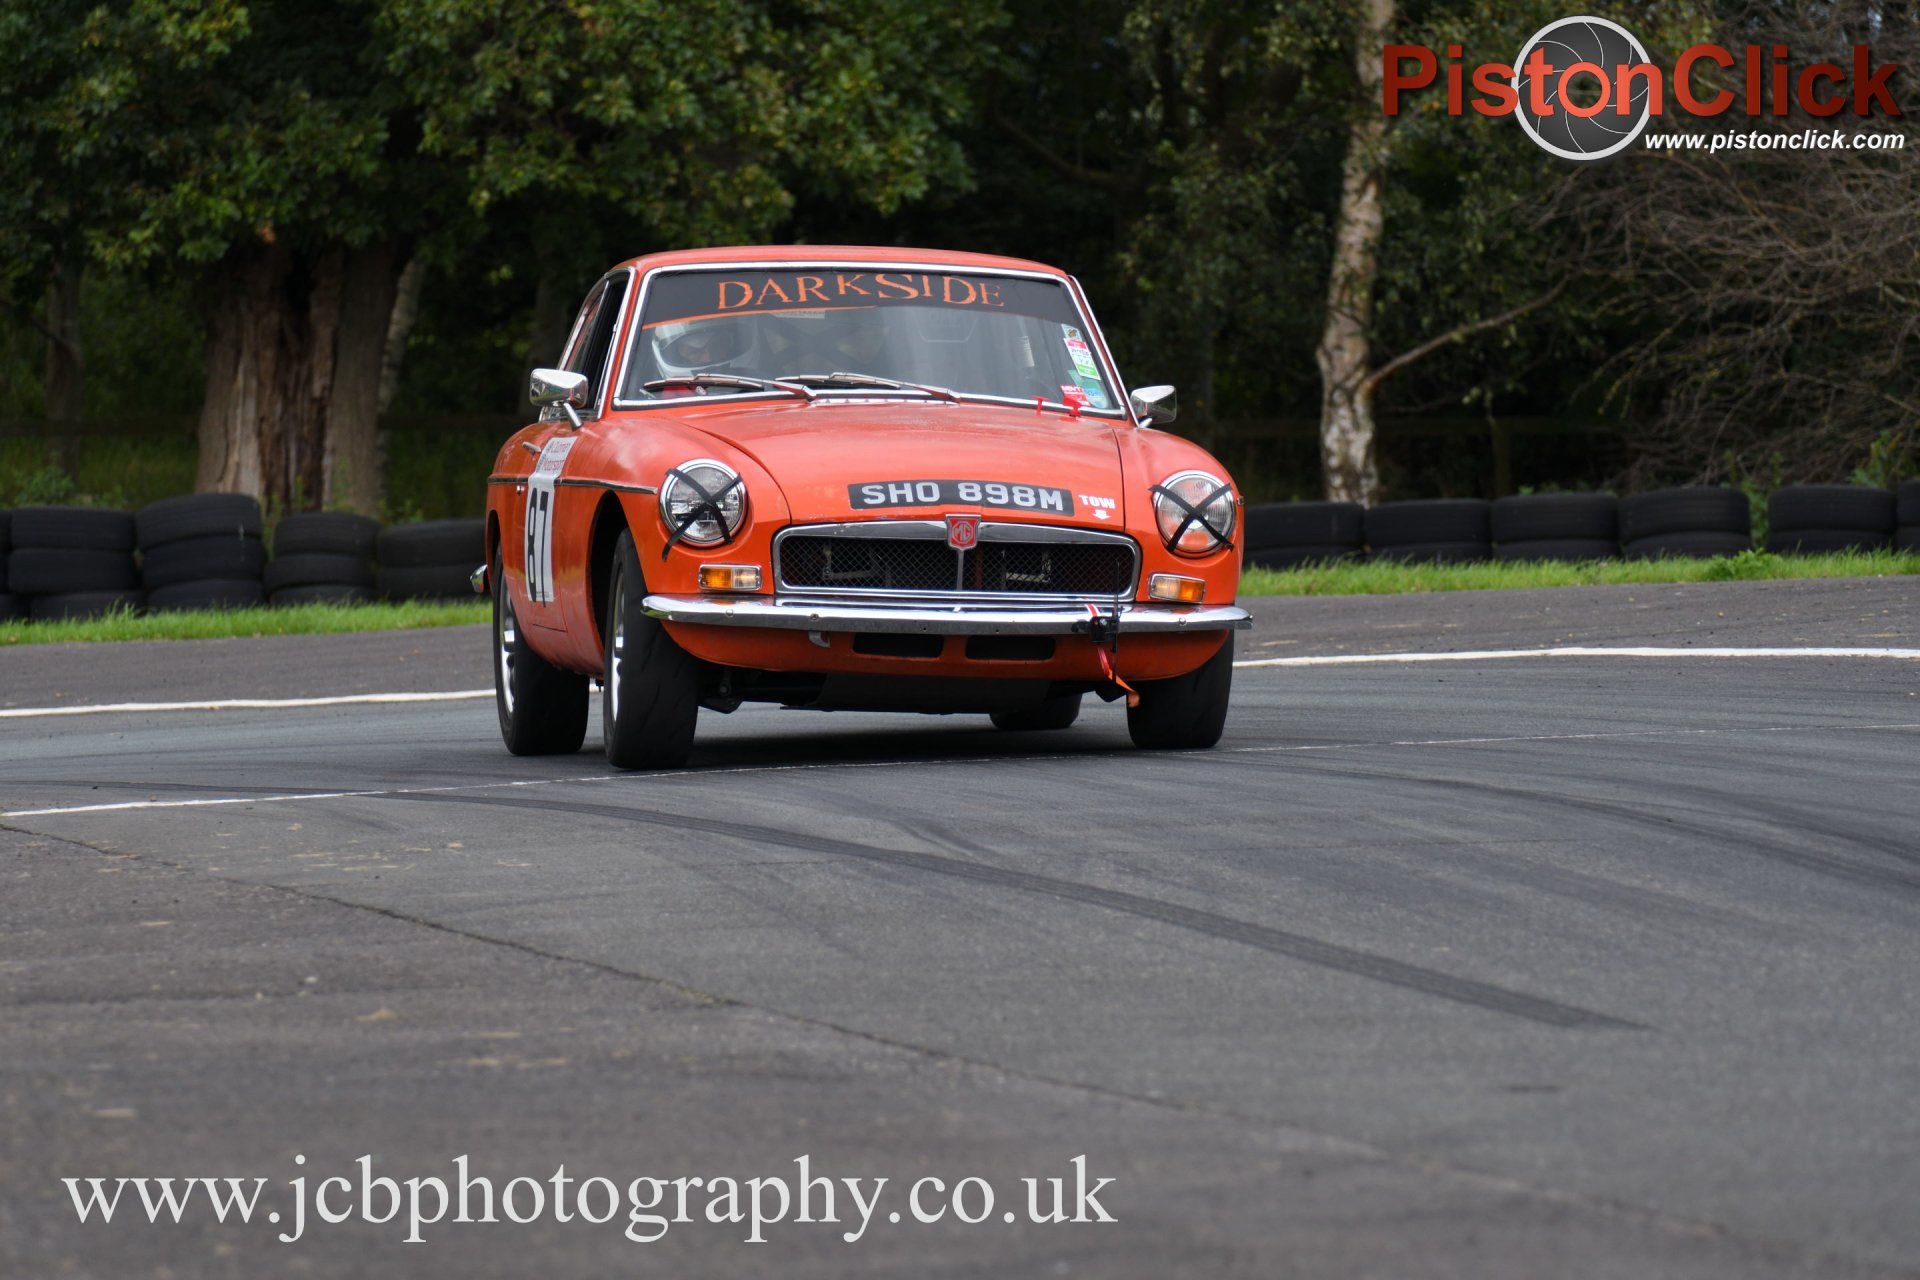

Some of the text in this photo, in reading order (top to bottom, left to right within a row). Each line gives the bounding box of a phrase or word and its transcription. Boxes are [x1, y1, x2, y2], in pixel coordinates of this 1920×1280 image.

[717, 273, 1005, 310] DARKSIDE
[861, 481, 1064, 512] SHO 898M
[1078, 494, 1116, 509] TOW
[527, 487, 549, 608] 87
[951, 521, 974, 544] MG
